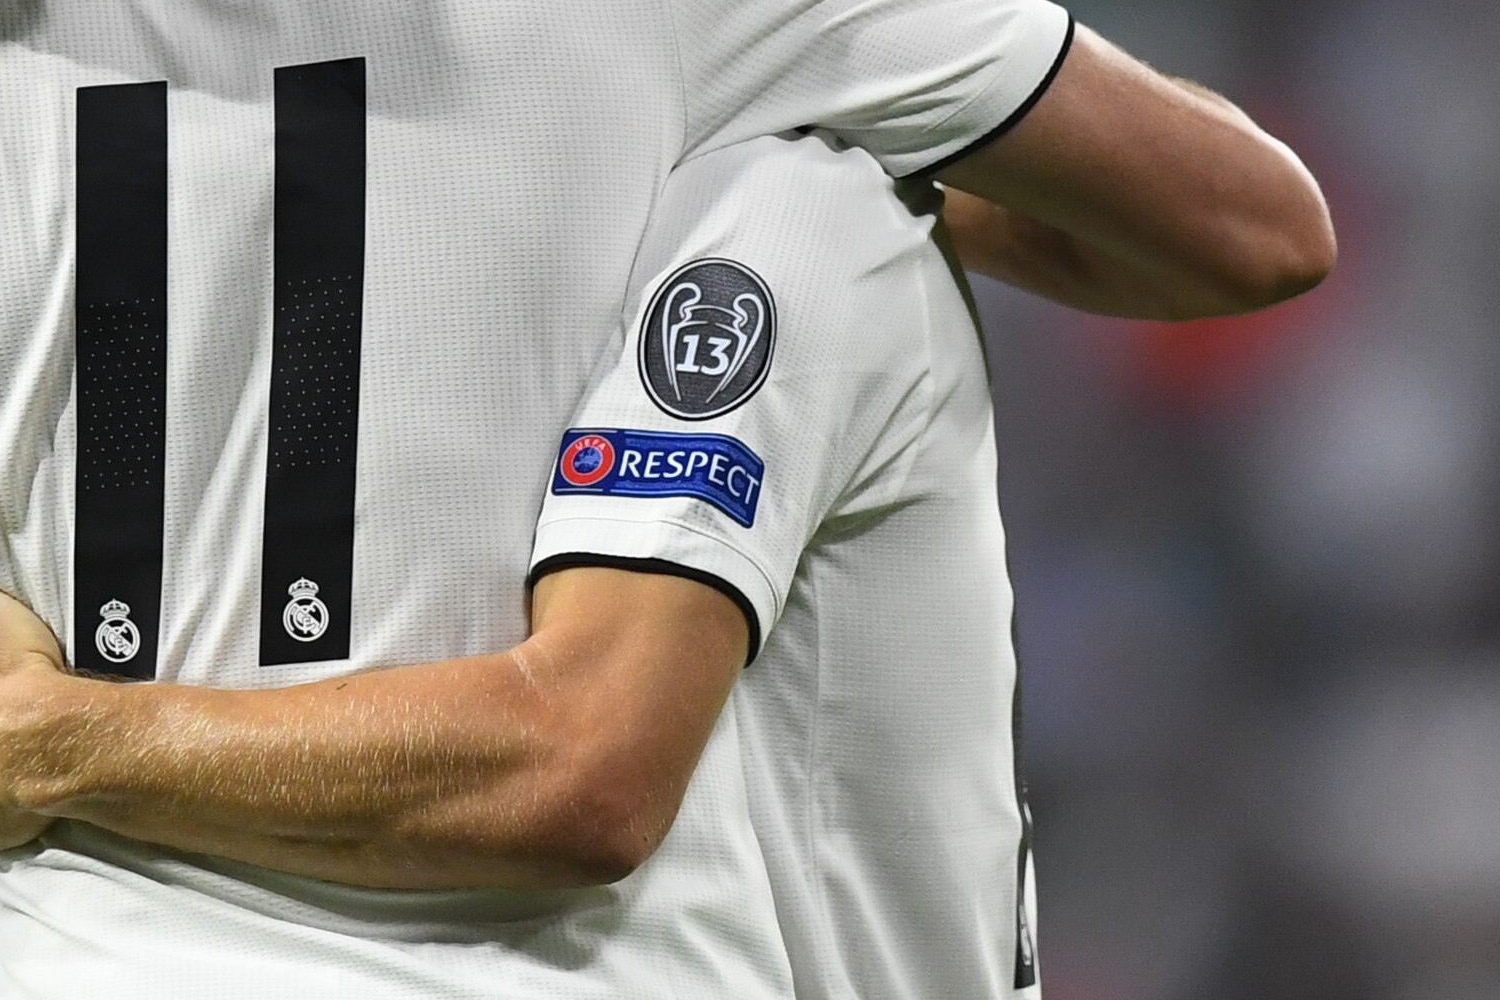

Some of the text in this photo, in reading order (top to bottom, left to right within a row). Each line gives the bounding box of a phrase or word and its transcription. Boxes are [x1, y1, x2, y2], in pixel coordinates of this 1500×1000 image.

[73, 57, 366, 682] 11
[676, 334, 732, 376] 13
[575, 439, 606, 451] UEFA
[618, 449, 760, 505] RESPECT
